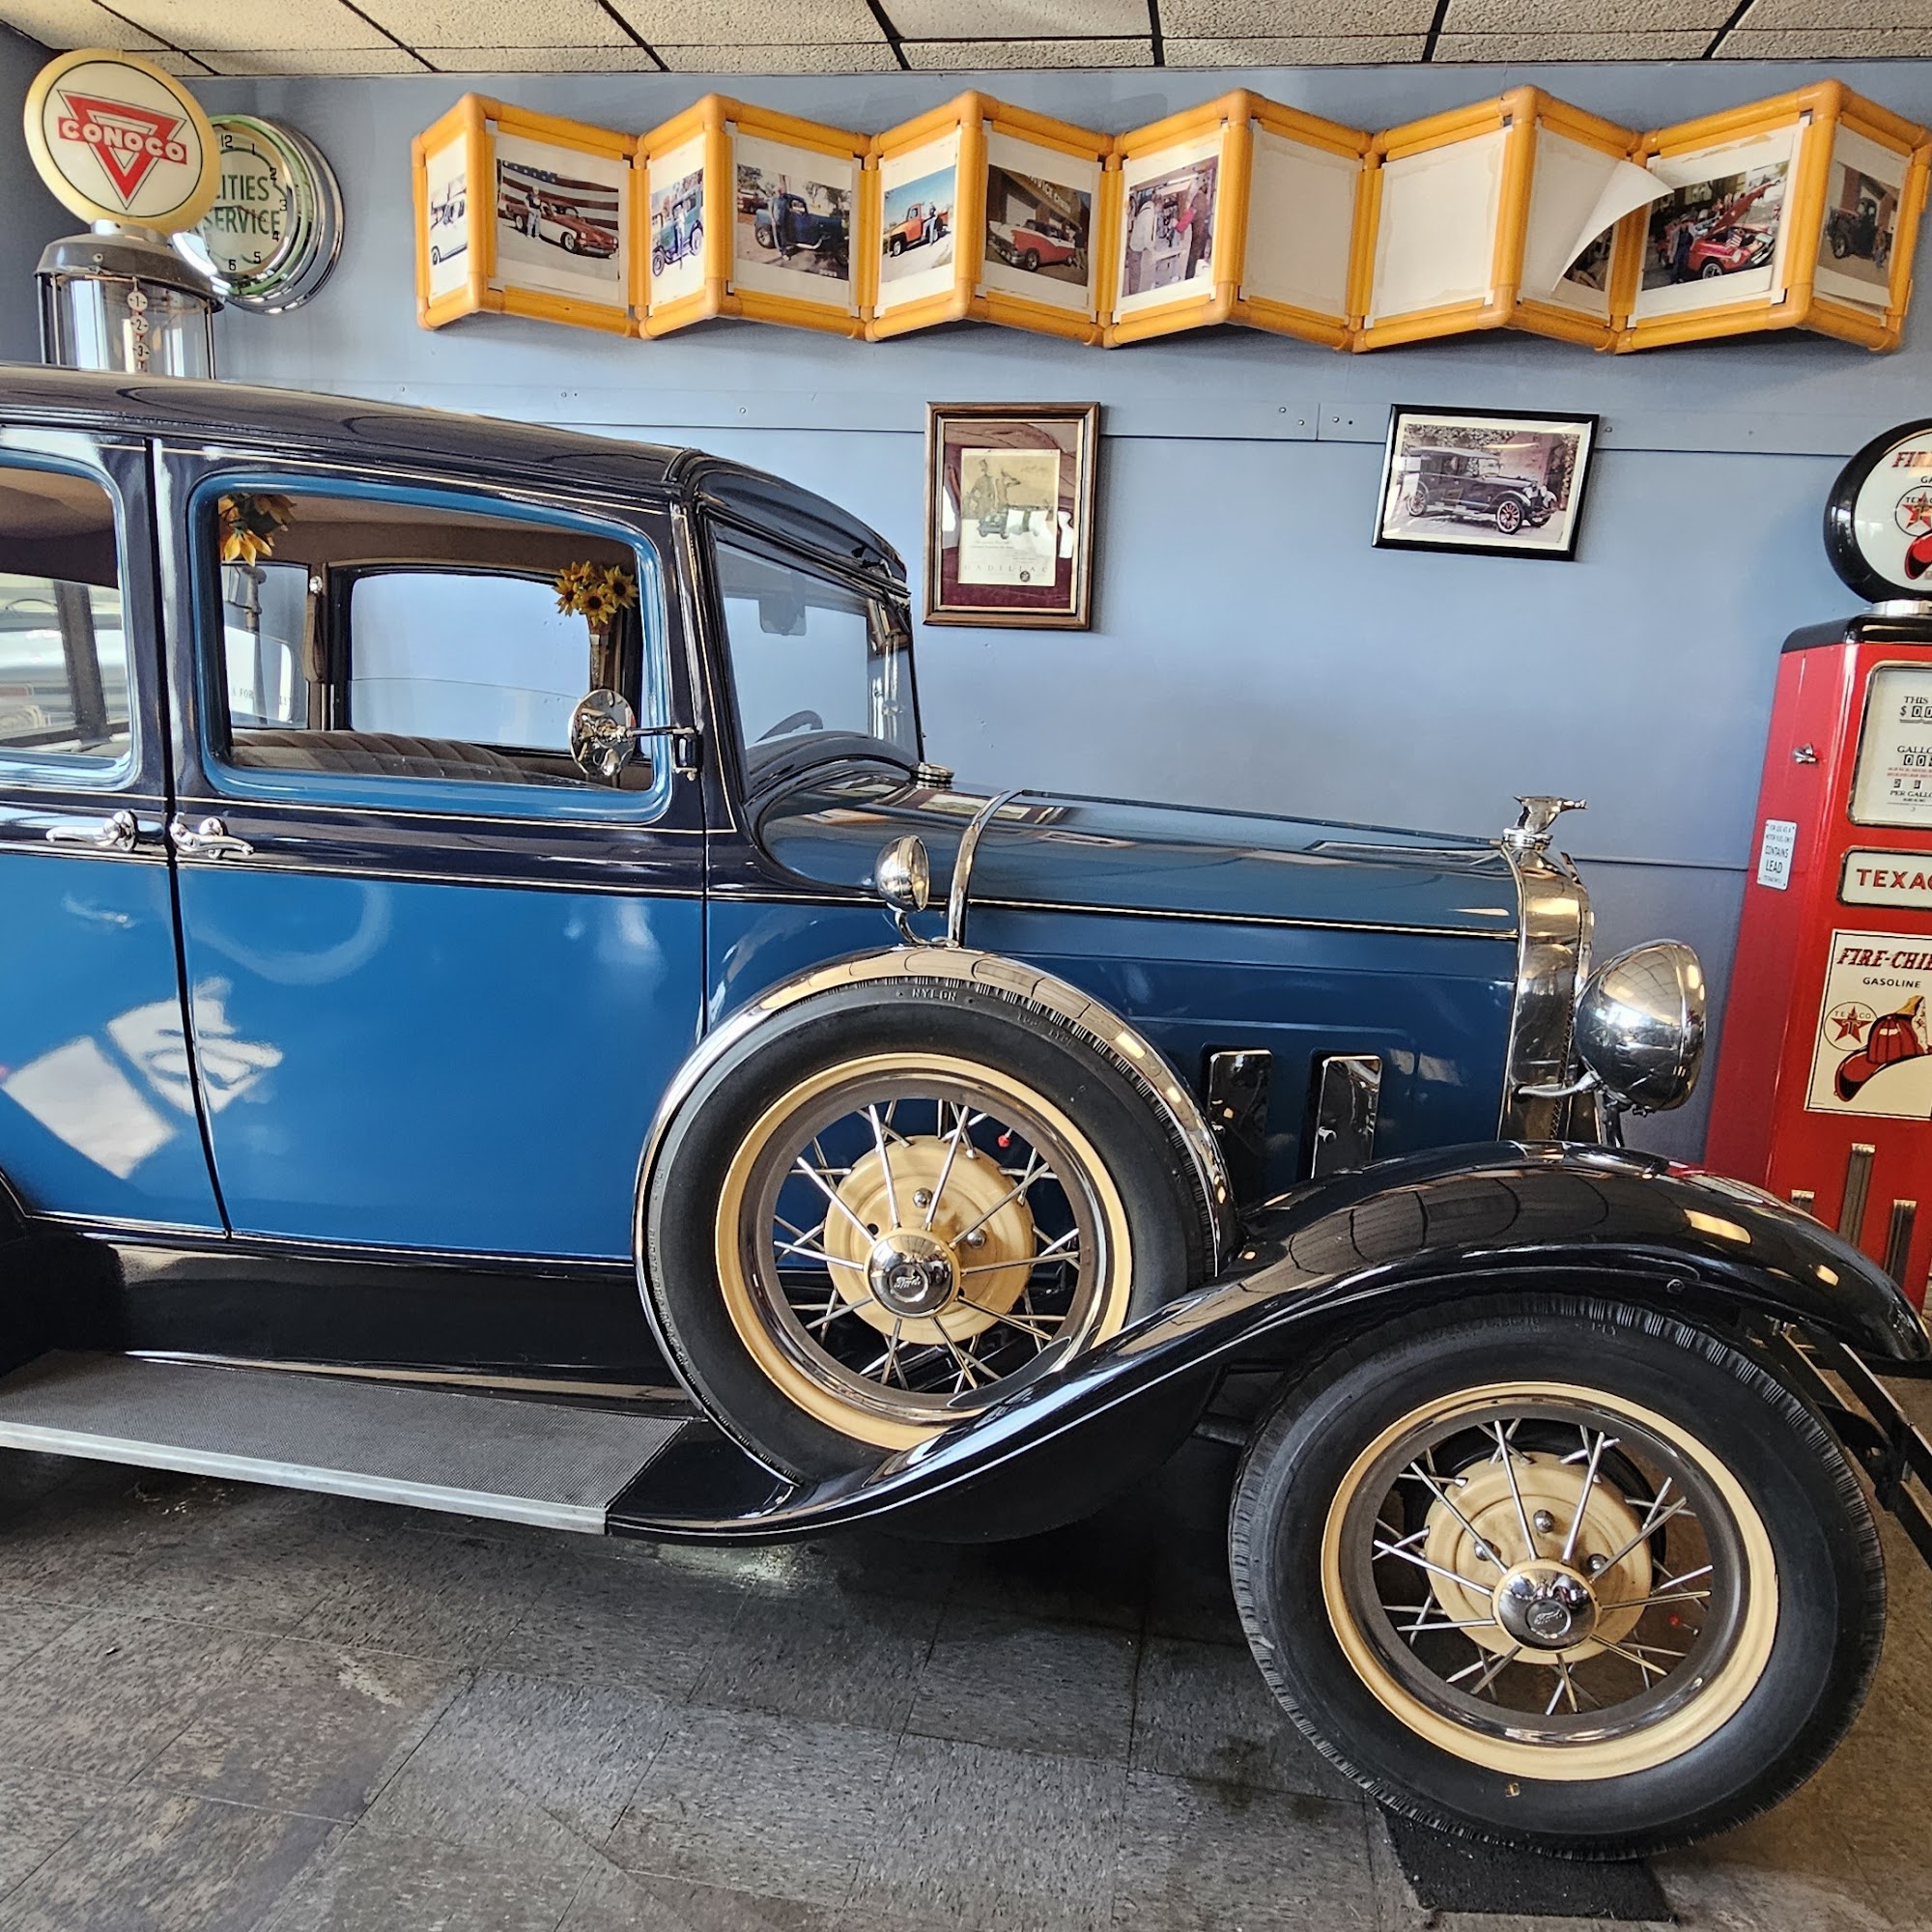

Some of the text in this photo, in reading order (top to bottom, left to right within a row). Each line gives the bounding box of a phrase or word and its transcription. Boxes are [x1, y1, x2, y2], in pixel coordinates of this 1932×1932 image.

[61, 119, 185, 162] CONOCO
[221, 134, 234, 148] 12
[216, 174, 270, 202] ITIES
[253, 251, 262, 265] 5
[135, 318, 142, 331] 2
[137, 345, 144, 357] 3
[1903, 696, 1929, 704] THIS
[1765, 844, 1789, 859] CONTAINS
[1765, 859, 1783, 874] LEAD
[1862, 977, 1921, 989] GASOLINE
[912, 987, 958, 1002] NYLON
